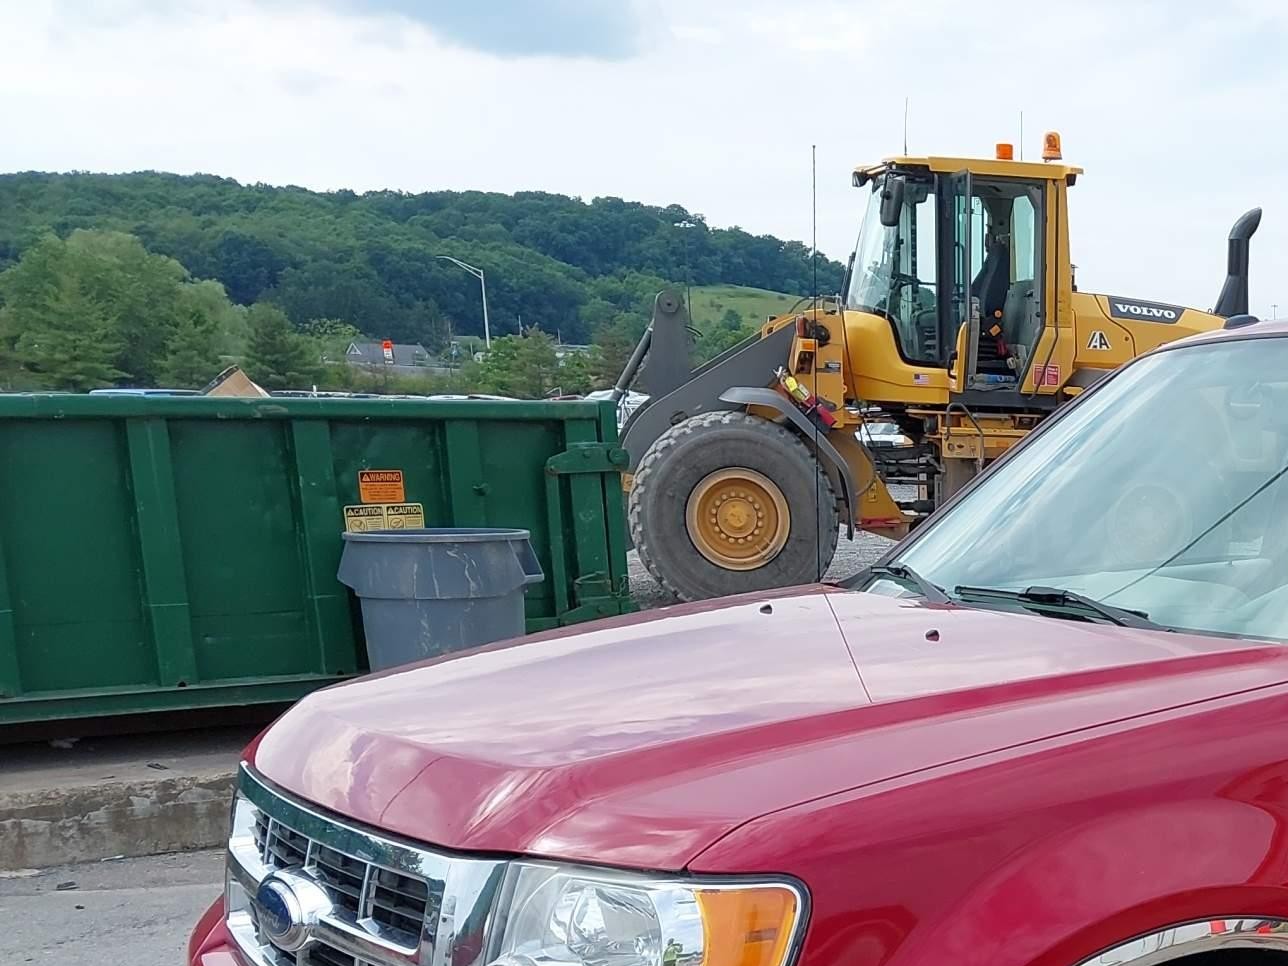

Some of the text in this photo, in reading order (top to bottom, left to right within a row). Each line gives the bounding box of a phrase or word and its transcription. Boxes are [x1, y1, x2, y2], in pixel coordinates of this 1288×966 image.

[1115, 303, 1176, 319] VOLVO
[369, 473, 401, 482] WARNING
[353, 507, 383, 516] CAUTION
[394, 505, 422, 515] CAUTION
